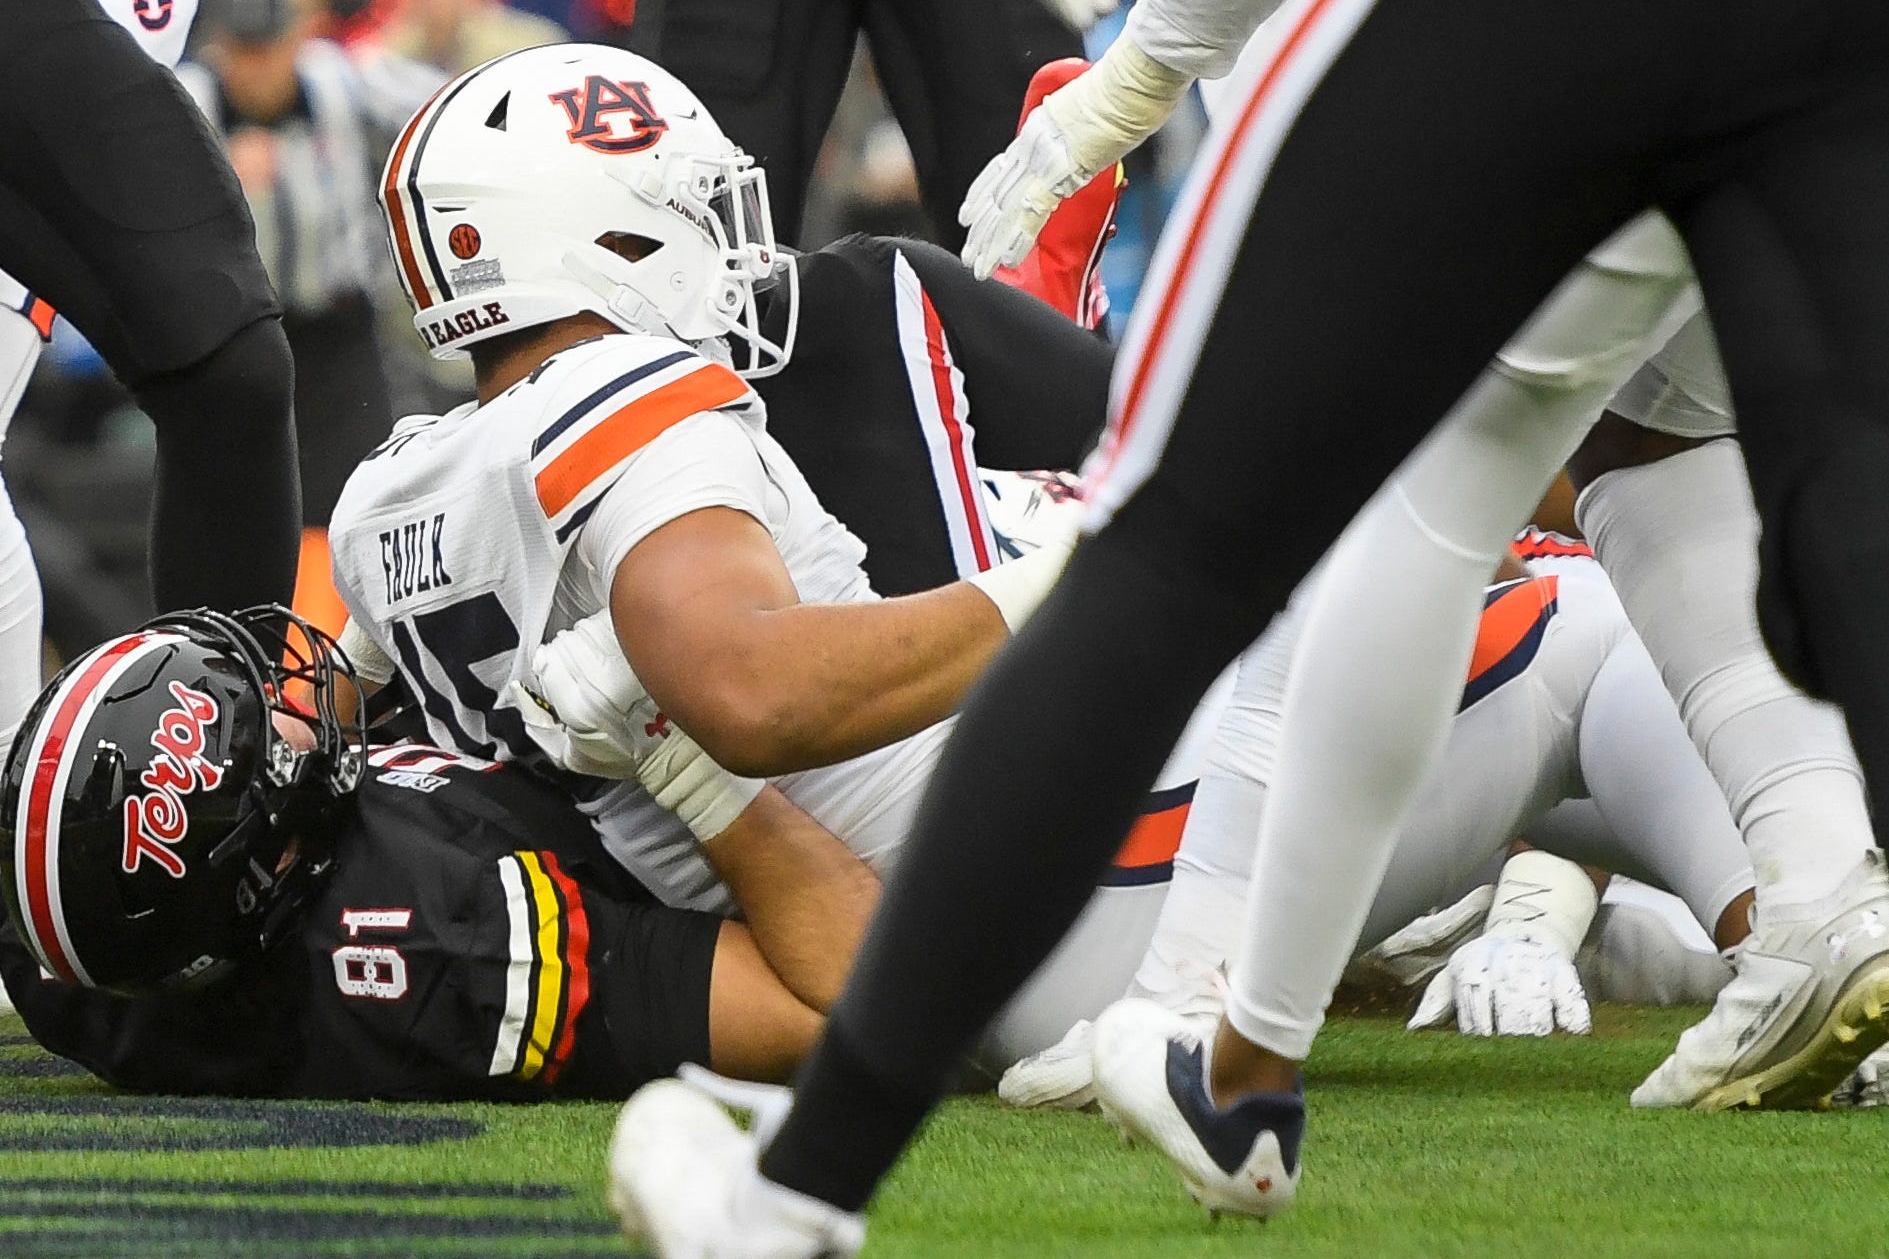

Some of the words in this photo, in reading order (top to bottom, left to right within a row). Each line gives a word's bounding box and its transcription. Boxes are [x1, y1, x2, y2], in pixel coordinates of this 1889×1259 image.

[378, 511, 453, 606] FAULK
[121, 679, 223, 879] Terps
[329, 907, 413, 1004] 81
